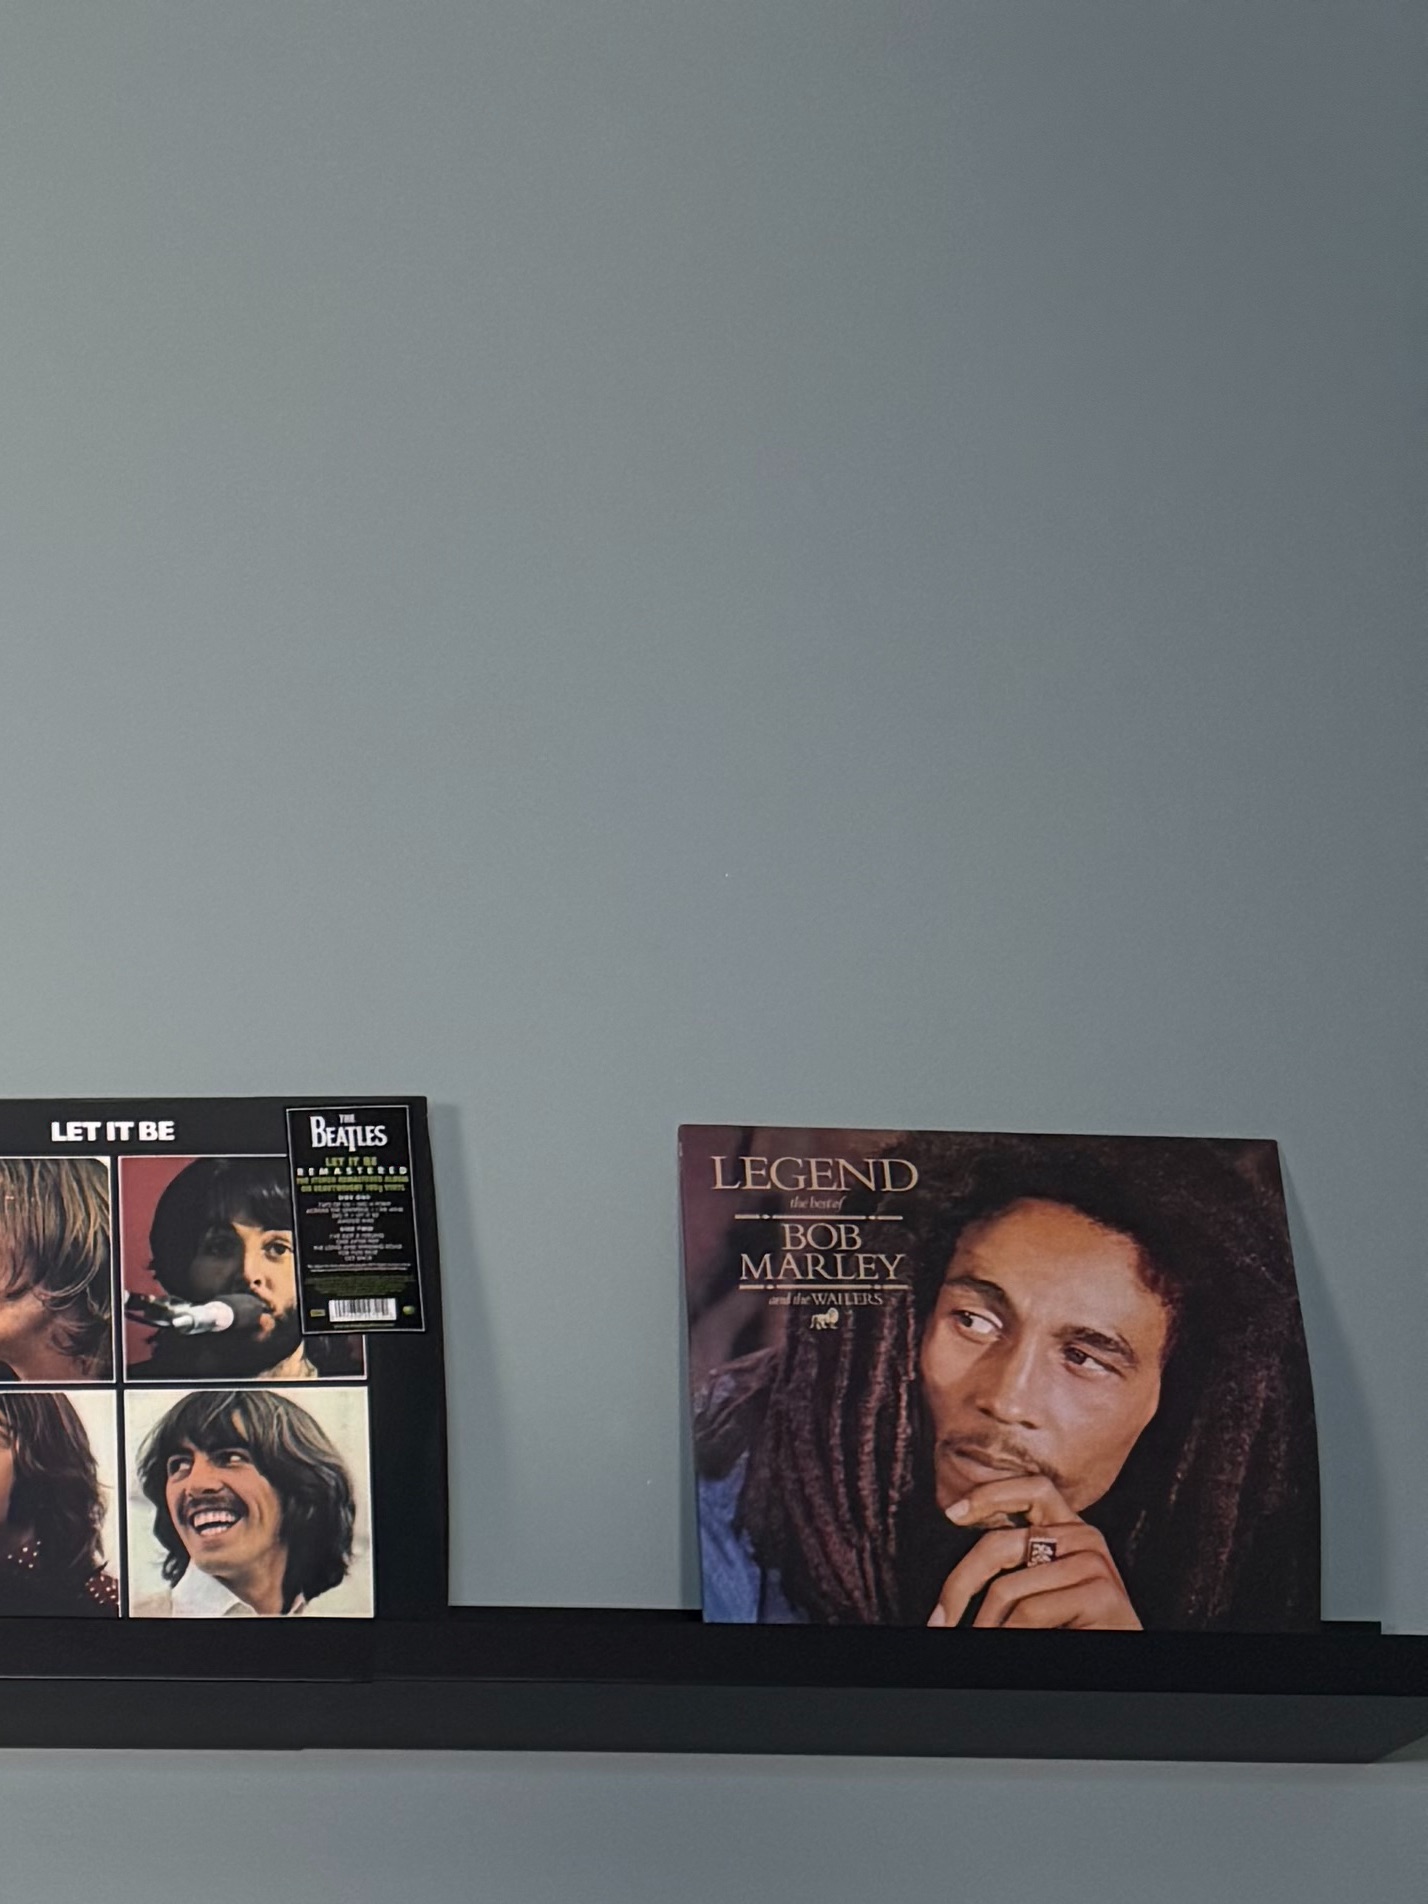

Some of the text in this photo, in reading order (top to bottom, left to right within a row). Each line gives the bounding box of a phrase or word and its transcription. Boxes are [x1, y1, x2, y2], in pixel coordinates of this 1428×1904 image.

[338, 1114, 355, 1124] THE
[50, 1120, 176, 1142] LET IT BE
[309, 1115, 389, 1152] BEATLES
[296, 1166, 408, 1177] REMASTERED
[325, 1156, 345, 1167] LET
[348, 1156, 360, 1167] IT
[710, 1156, 919, 1192] LEGEND
[781, 1222, 862, 1251] BOB
[739, 1252, 906, 1281] MARLEY
[810, 1292, 884, 1306] WAILERS
